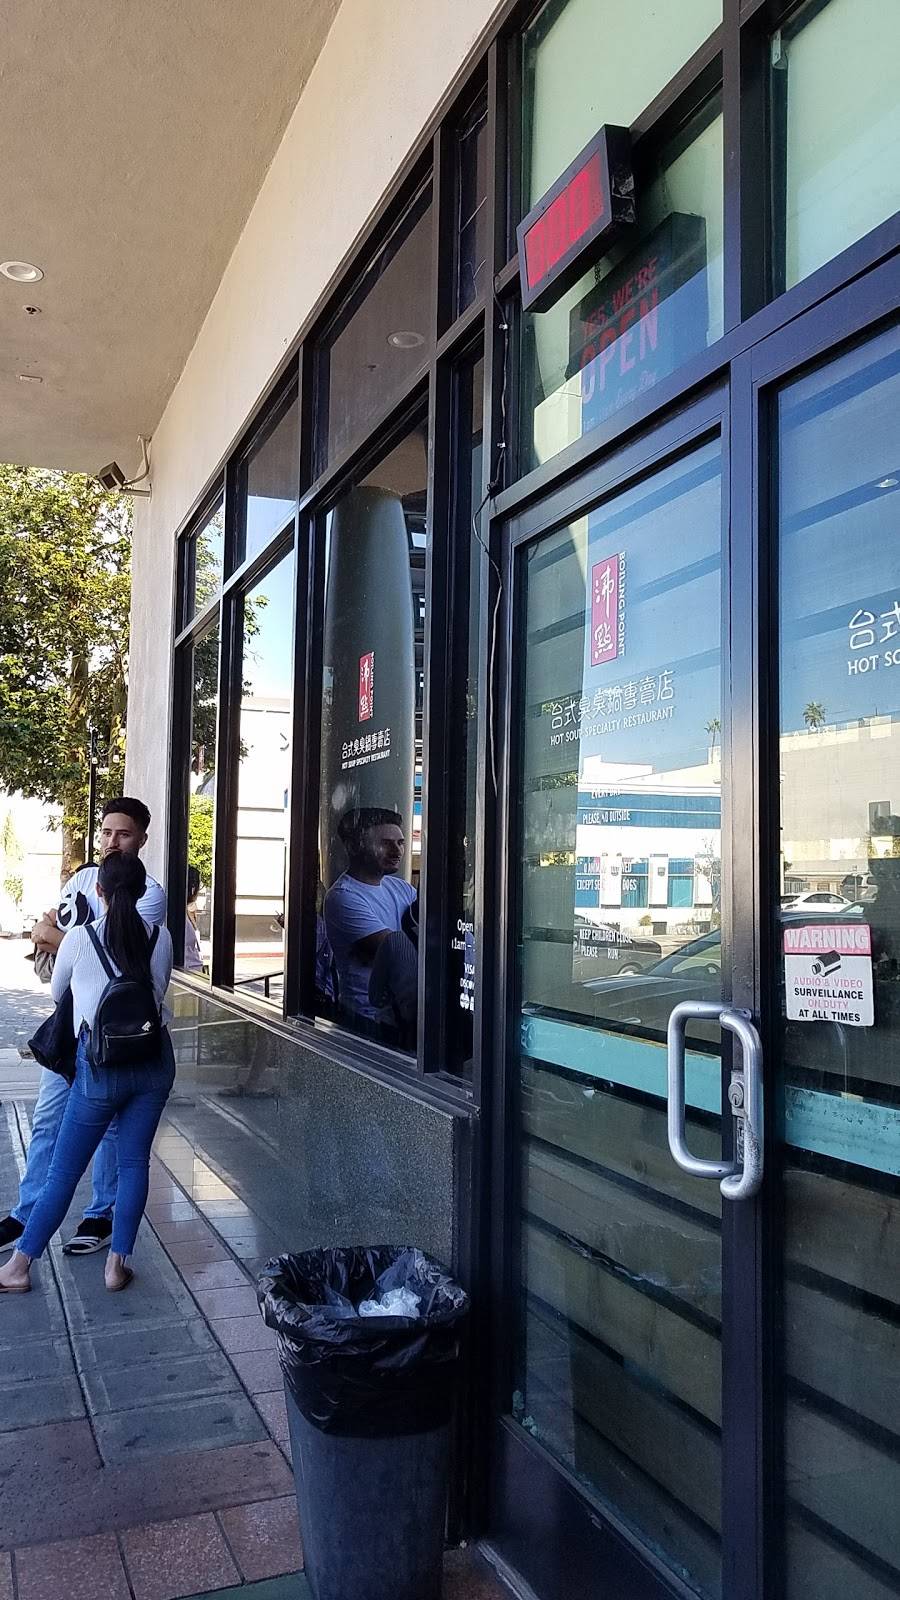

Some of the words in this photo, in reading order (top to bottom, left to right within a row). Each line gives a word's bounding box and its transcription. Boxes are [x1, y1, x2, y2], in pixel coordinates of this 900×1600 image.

[579, 288, 658, 405] OPEN
[618, 551, 626, 613] BOILING
[618, 614, 626, 657] POINT
[847, 654, 879, 676] HOT
[550, 733, 565, 747] HOT
[584, 719, 621, 737] SPECIALTY
[623, 706, 675, 729] RESTAURANT
[609, 808, 631, 823] OUTSIDE
[457, 919, 474, 934] Open
[786, 928, 869, 949] WARNING
[580, 945, 598, 958] PLEASE
[793, 976, 823, 987] AUDIO
[825, 978, 831, 987] &
[834, 979, 863, 989] VIDEO
[794, 987, 864, 1000] SURVEILLANCE
[808, 998, 821, 1008] ON
[821, 999, 849, 1010] DUTY
[798, 1008, 809, 1018] AT
[811, 1009, 829, 1020] ALL
[831, 1010, 861, 1023] TIMES
